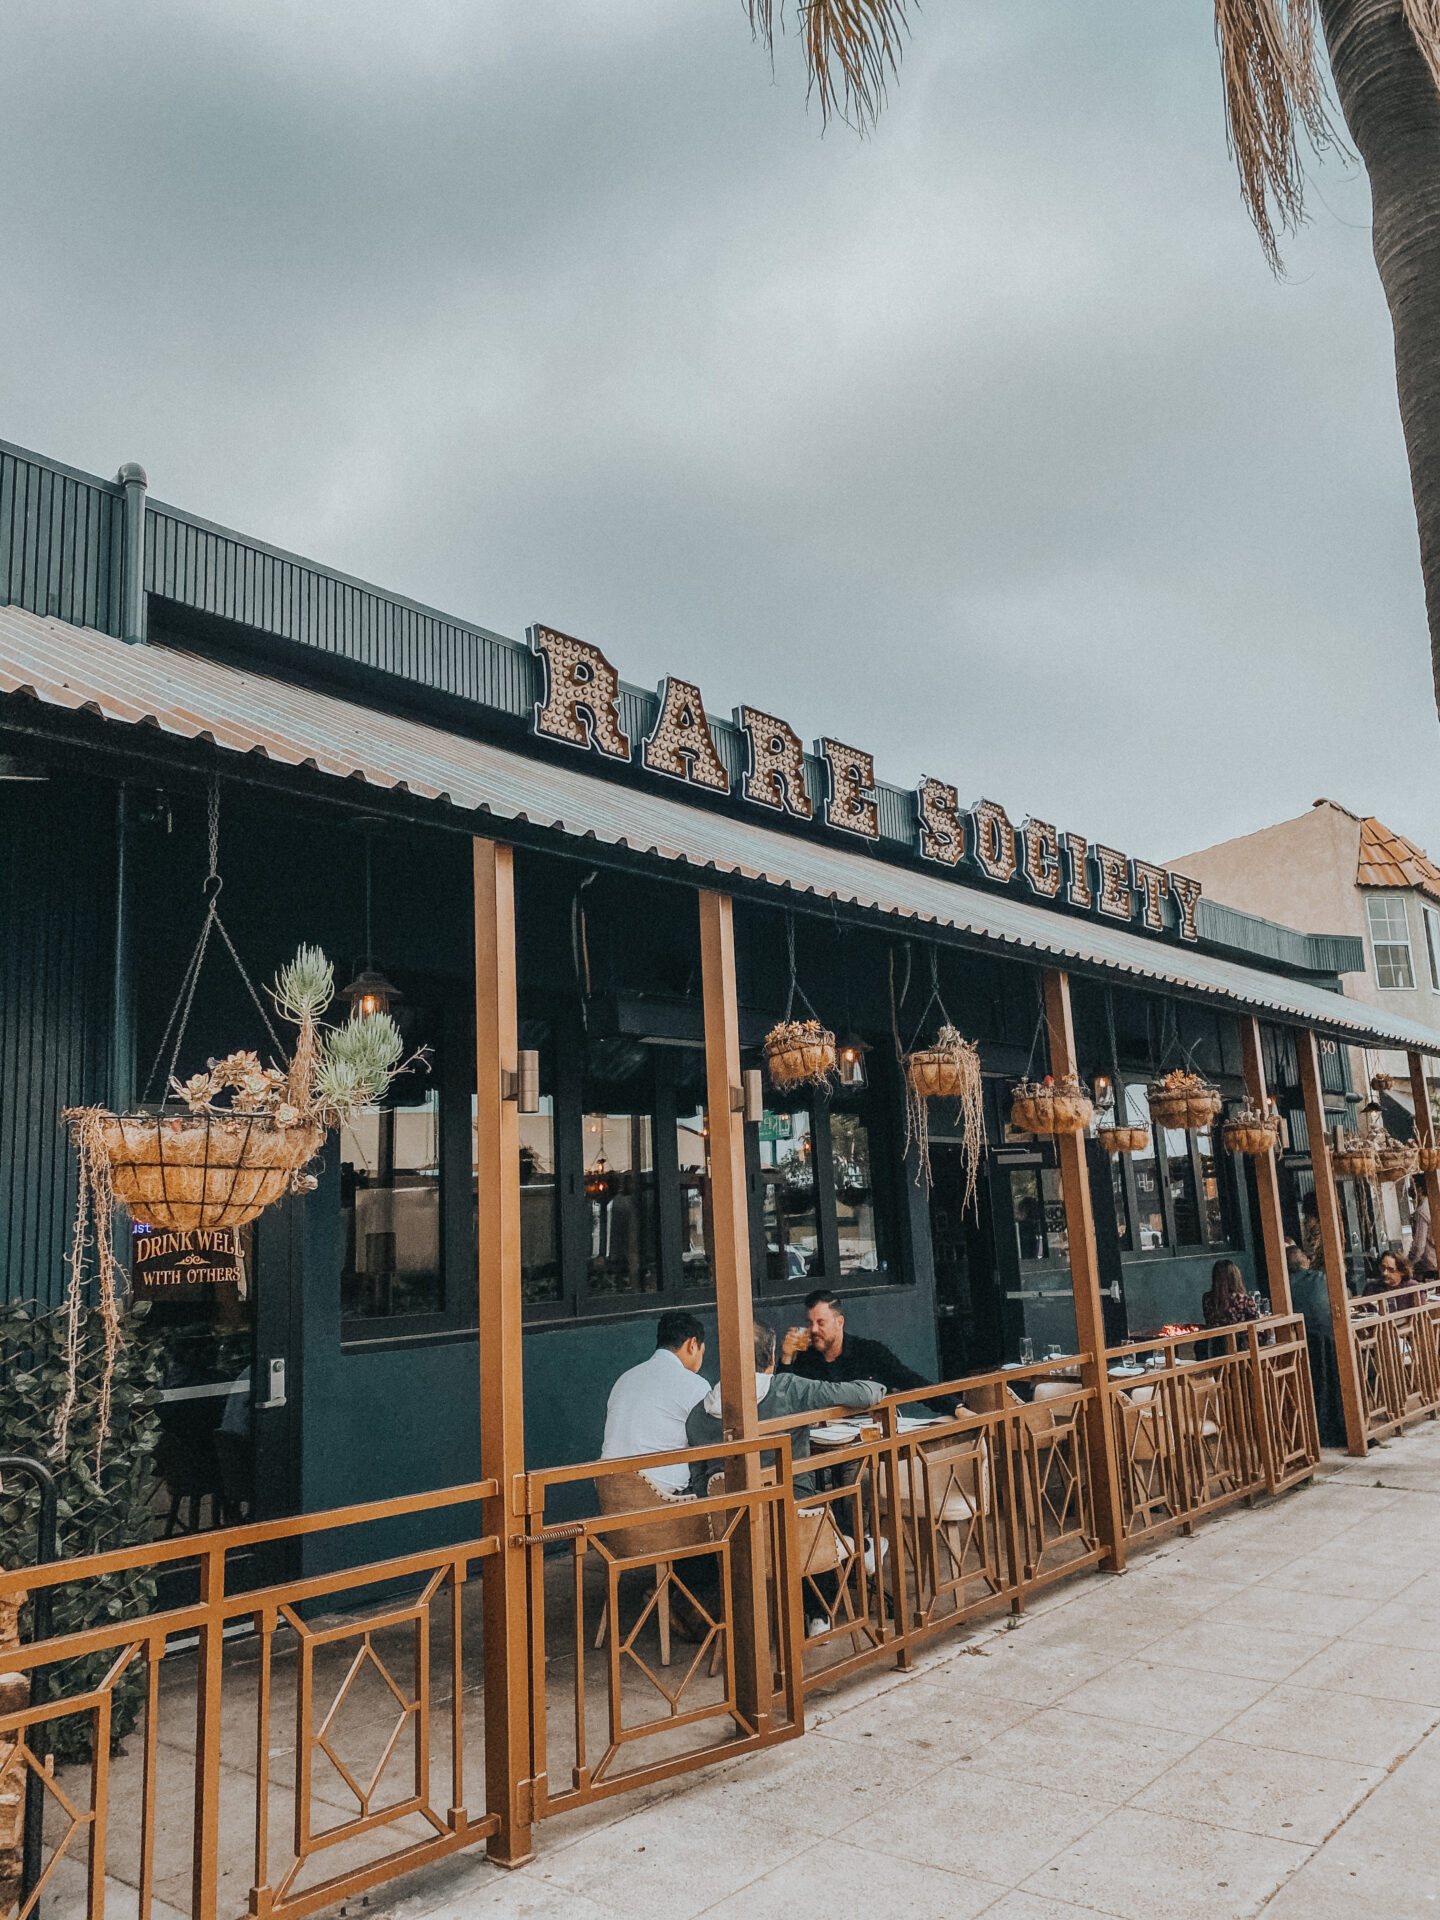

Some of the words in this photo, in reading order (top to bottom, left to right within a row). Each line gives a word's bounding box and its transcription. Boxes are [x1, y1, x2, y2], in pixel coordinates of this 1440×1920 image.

[526, 622, 880, 841] RARE
[915, 775, 1202, 942] SOCIETY
[136, 1230, 194, 1263] DRINK
[195, 1228, 246, 1258] WELL
[143, 1270, 181, 1286] WITH
[186, 1266, 241, 1284] OTHERS
